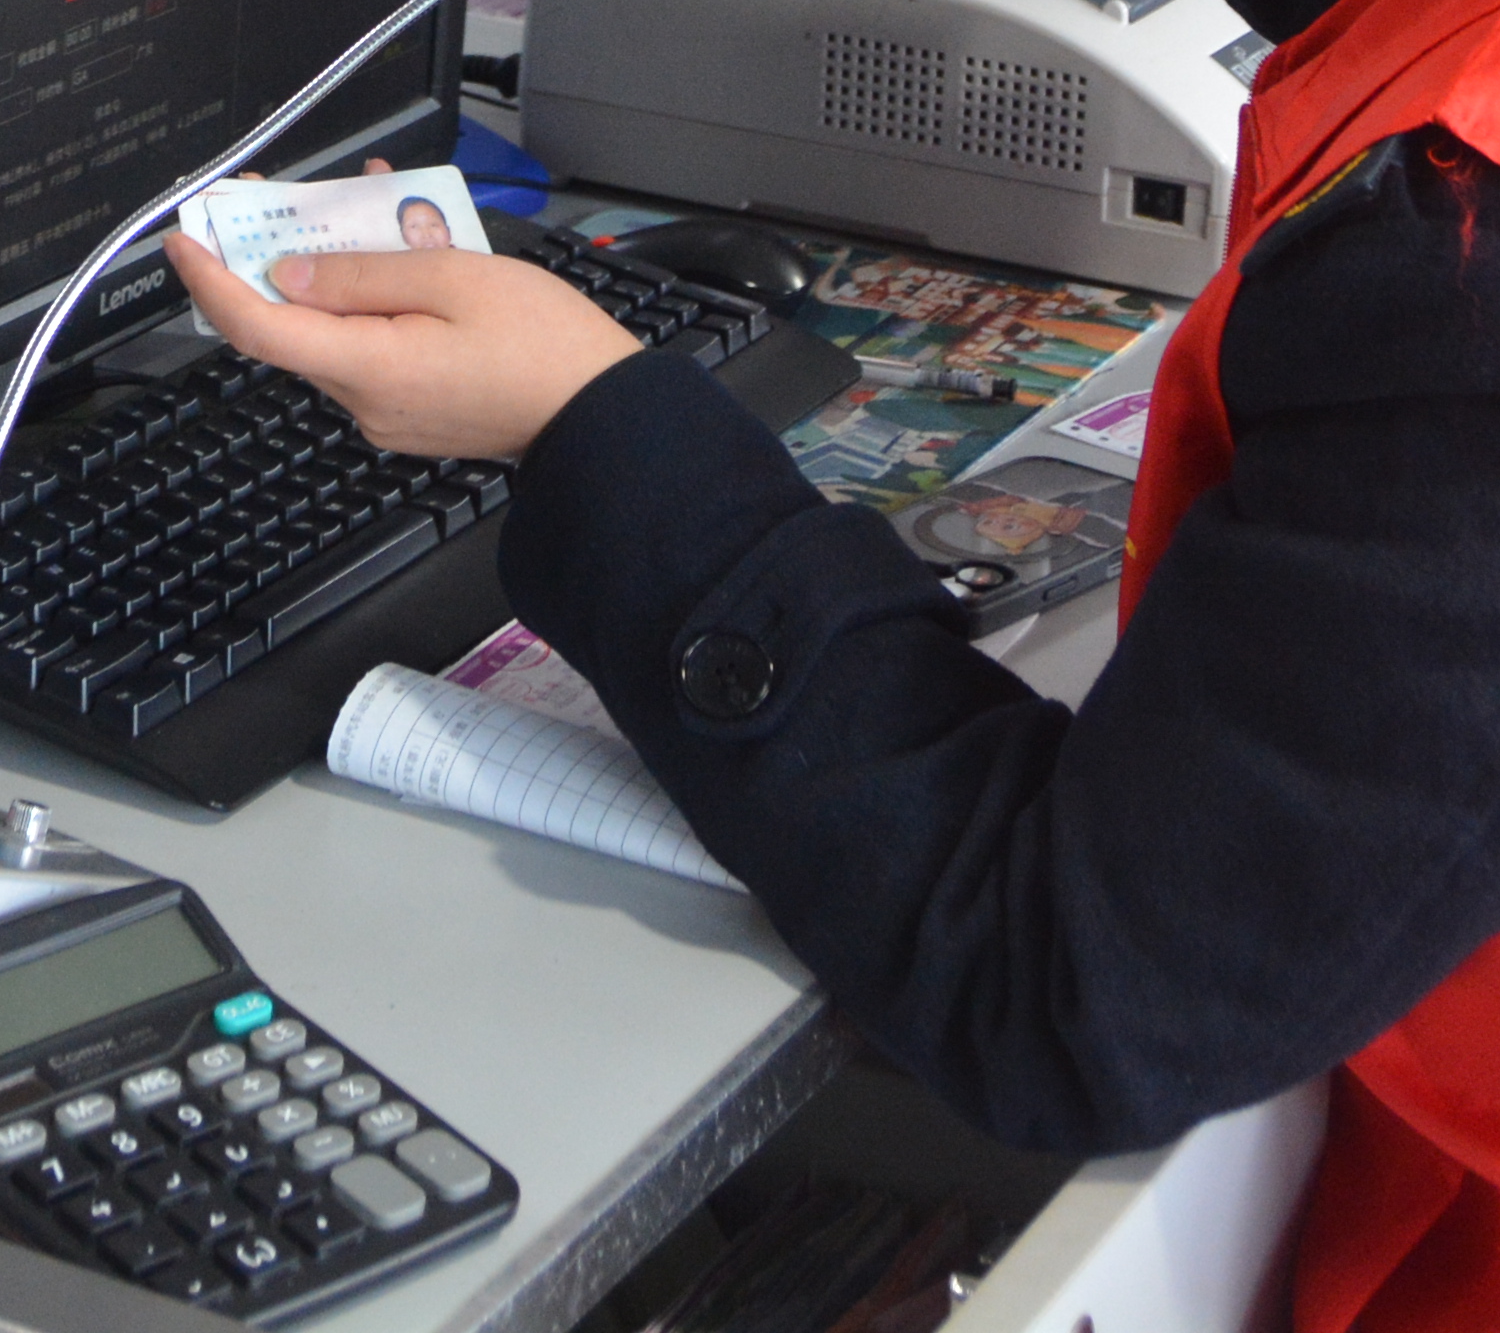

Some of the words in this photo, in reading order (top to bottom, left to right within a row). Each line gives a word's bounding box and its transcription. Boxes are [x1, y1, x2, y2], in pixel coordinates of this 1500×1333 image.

[98, 267, 166, 317] Lenovo
[177, 1103, 203, 1128] 9
[111, 1130, 139, 1154] 8
[41, 1156, 65, 1183] 7
